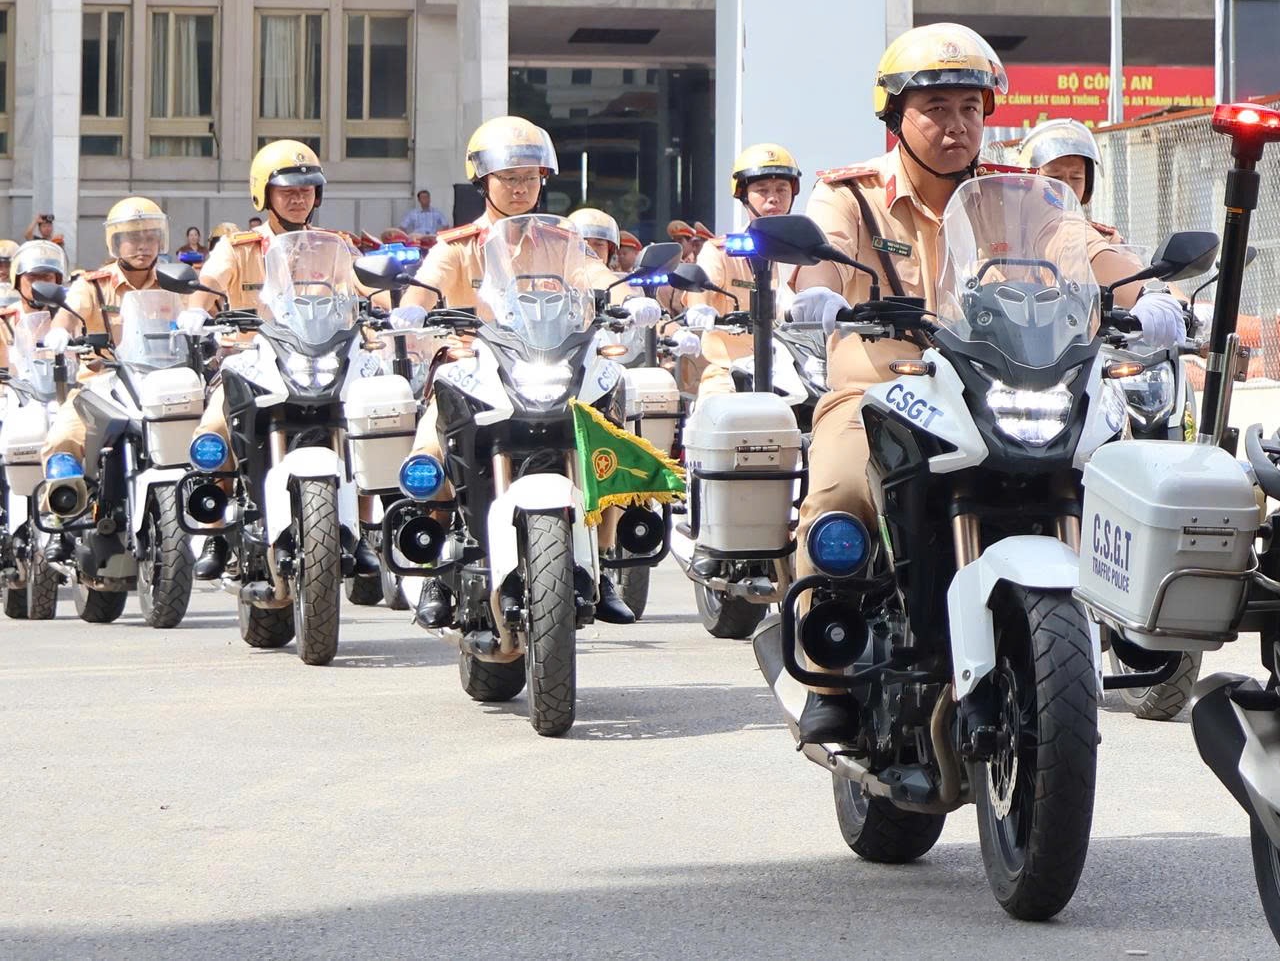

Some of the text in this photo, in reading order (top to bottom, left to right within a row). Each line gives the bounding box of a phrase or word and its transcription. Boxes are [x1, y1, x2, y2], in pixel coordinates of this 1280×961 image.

[1057, 72, 1079, 92] BỘ
[1130, 75, 1153, 91] AN
[1093, 513, 1132, 572] C.S.G.T
[1092, 555, 1111, 583] TRAFFIC
